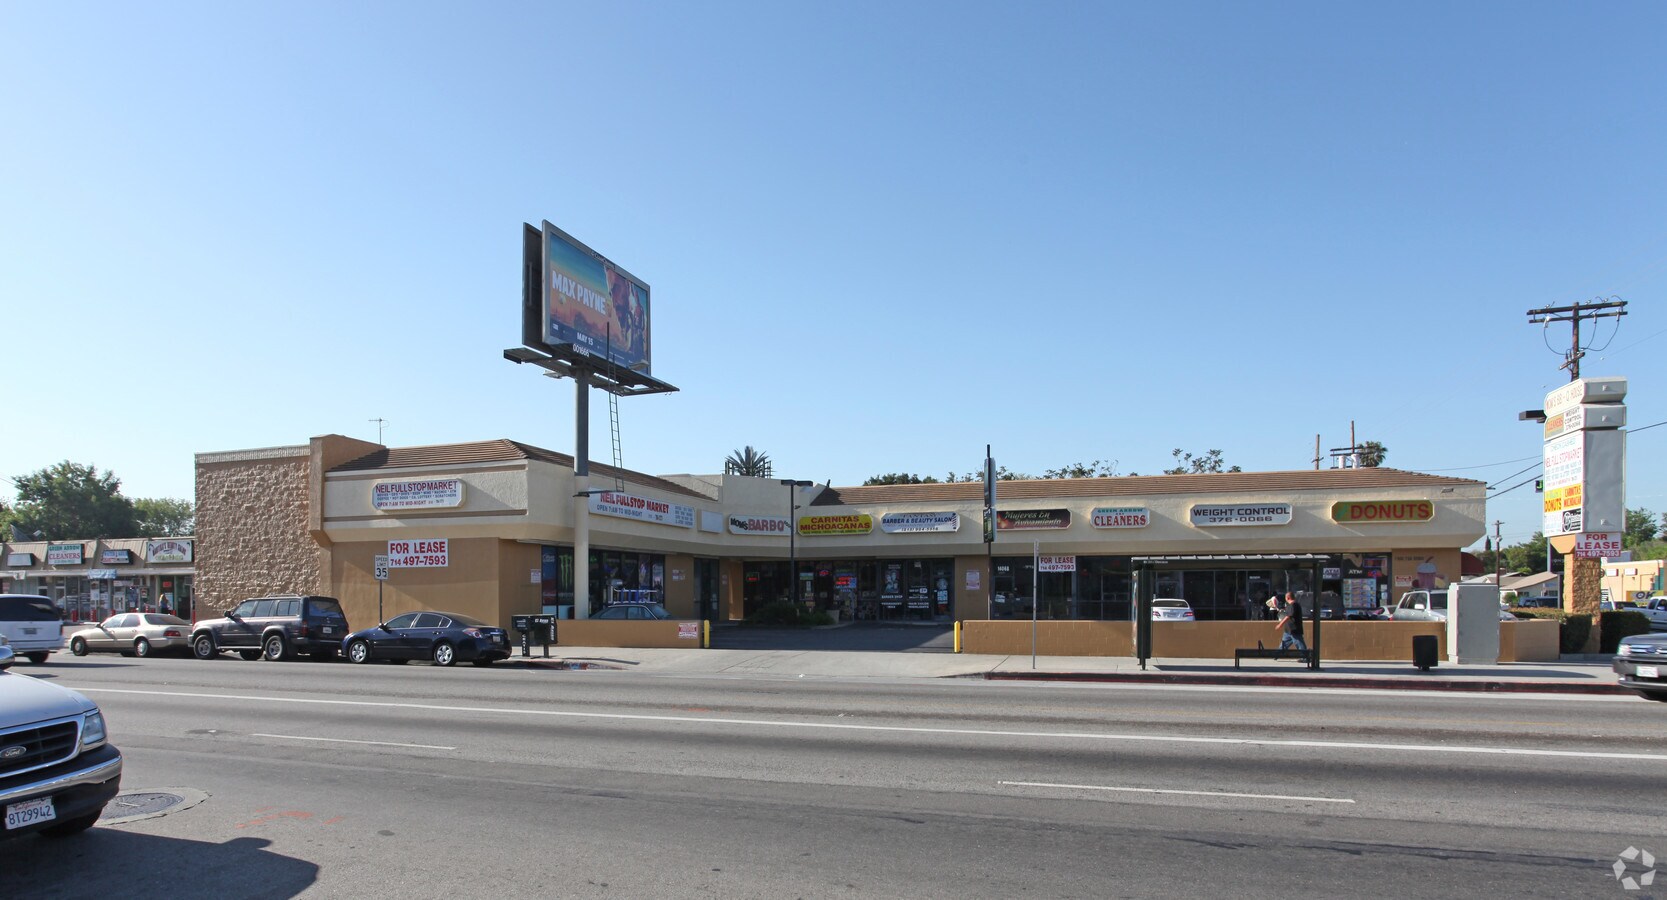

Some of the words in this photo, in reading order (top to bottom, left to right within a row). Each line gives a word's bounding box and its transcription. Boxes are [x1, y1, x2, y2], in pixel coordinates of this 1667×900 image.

[552, 270, 576, 300] MAX
[577, 283, 606, 315] PAYNE
[576, 332, 587, 344] MAY
[588, 337, 594, 346] 15
[600, 492, 615, 505] NEIL
[646, 500, 669, 514] MARKET
[1193, 508, 1235, 517] WEIGHT
[1237, 507, 1290, 516] CONTROL
[1350, 503, 1430, 519] DONUTS
[810, 515, 860, 524] CARNITAS
[1094, 514, 1147, 526] CLEANERS
[800, 523, 871, 531] MICHOACANAS
[390, 543, 410, 555] FOR
[414, 541, 446, 554] LEASE
[1577, 541, 1620, 550] LEASE
[49, 552, 80, 560] CLEANERS
[403, 555, 446, 566] 497-7593
[1055, 556, 1074, 564] LEASE
[376, 567, 388, 578] 35
[5, 748, 21, 757] Ford
[8, 805, 52, 825] 8T29942
